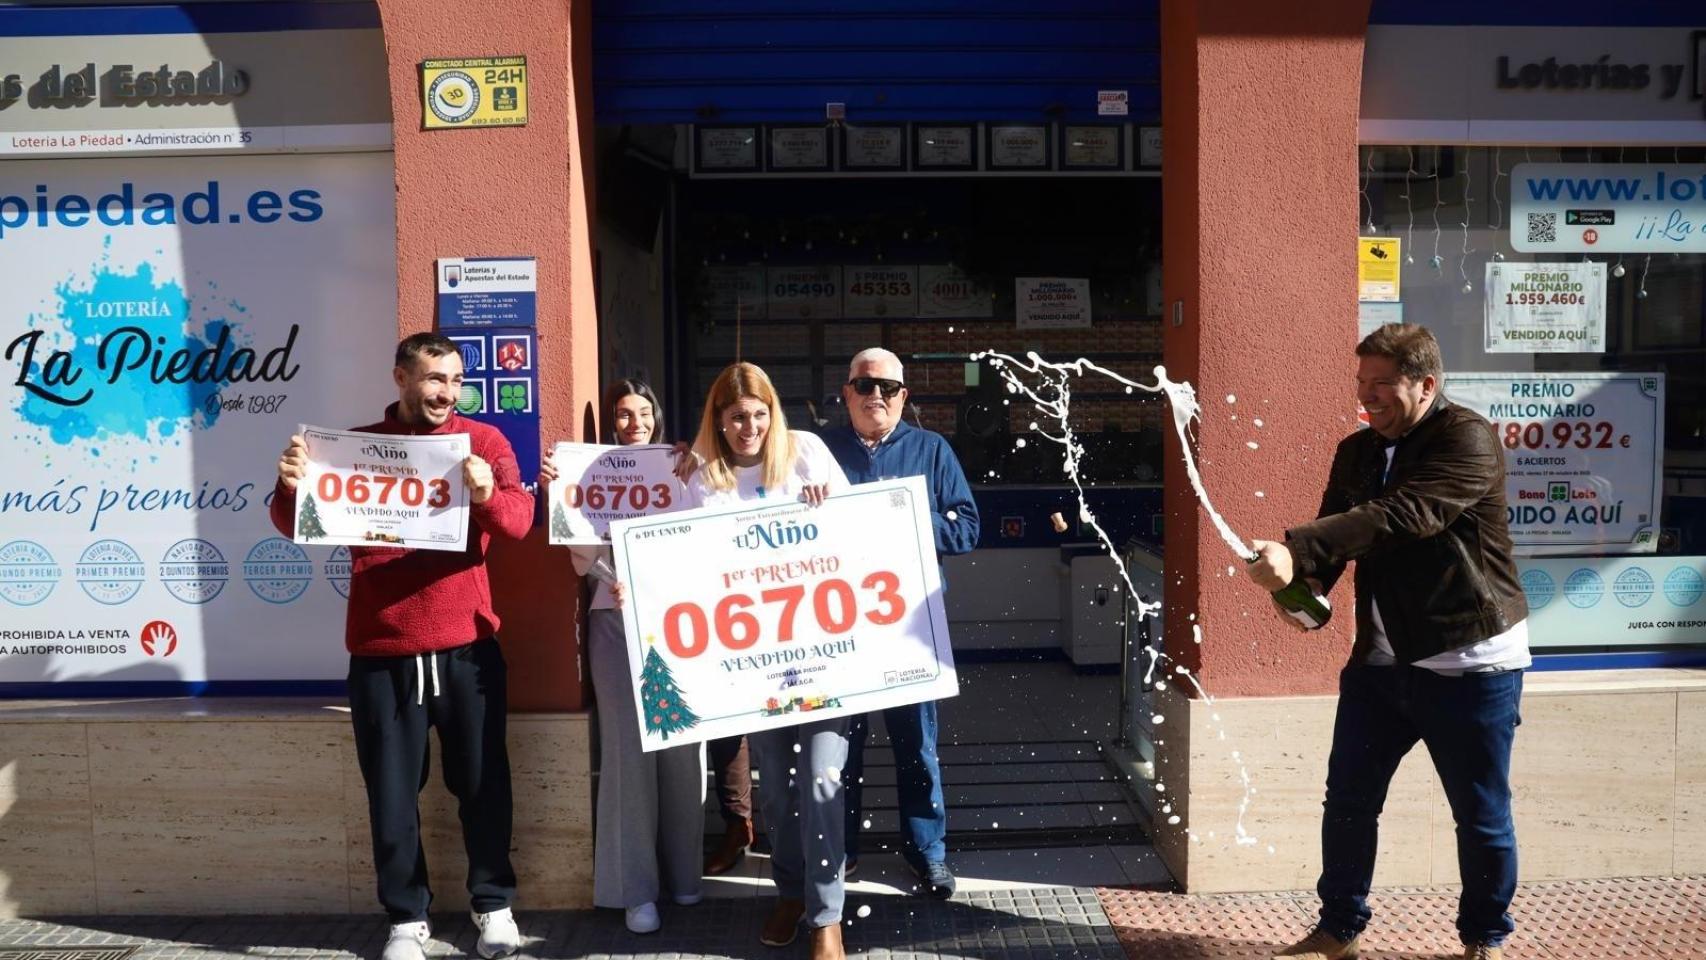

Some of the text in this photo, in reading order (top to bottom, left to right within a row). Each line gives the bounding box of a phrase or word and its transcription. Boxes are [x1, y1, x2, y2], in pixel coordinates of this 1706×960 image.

[425, 56, 525, 69] CONECTADO CENTRAL ALARMAS
[0, 61, 244, 99] s del Estado
[485, 68, 523, 84] 24H
[1496, 54, 1685, 100] Loterías y
[447, 88, 464, 100] 3D
[62, 136, 76, 147] La
[80, 134, 124, 147] Piedad
[134, 131, 220, 145] Administración
[239, 131, 252, 144] 35
[1600, 216, 1612, 224] Play
[464, 275, 494, 283] Apuestas
[508, 273, 530, 281] Estado
[492, 267, 497, 275] y
[864, 272, 907, 281] PREMIO
[1524, 273, 1569, 282] PREMIO
[775, 283, 835, 298] 05490
[850, 282, 912, 297] 45353
[1510, 282, 1583, 292] MILLONARIO
[85, 297, 172, 318] LOTERÍA
[1503, 326, 1587, 341] VENDIDO AQUÍ
[5, 323, 301, 407] La Piedad
[1511, 383, 1574, 398] PREMIO
[205, 393, 288, 416] Desde 1987
[1489, 404, 1595, 418] MILLONARIO
[1619, 434, 1631, 448] €
[369, 444, 408, 460] Niño
[604, 455, 637, 469] Niño
[1517, 457, 1566, 466] 6 ACIERTOS
[368, 464, 418, 476] PREMIO
[603, 474, 644, 484] PREMIO
[317, 472, 452, 509] 06703
[564, 483, 672, 511] 06703
[1519, 490, 1545, 500] Bono
[2, 480, 88, 513] más
[90, 481, 255, 532] premios
[345, 506, 419, 520] VENDIDO AQUÍ
[1564, 500, 1623, 525] AQUÍ
[587, 512, 623, 520] VENDIDO
[658, 525, 691, 537] ENERO
[732, 519, 818, 550] El Niño
[171, 543, 204, 560] NAVIDAD
[0, 567, 62, 577] UNDO PREMIO
[76, 566, 145, 577] PRIMER PREMIO
[160, 565, 229, 577] 2 QUINTOS PREMIOS
[243, 565, 313, 575] TERCER PREMIO
[751, 555, 840, 585] PREMIO
[663, 570, 906, 659] 06703
[1628, 621, 1654, 629] JUEGA
[68, 630, 85, 640] LA
[88, 629, 130, 639] VENTA
[11, 645, 127, 655] AUTOPROHIBIDOS
[720, 635, 856, 673] VENDIDO AQUÍ
[793, 669, 802, 677] LA
[803, 665, 827, 674] PIEDAD
[900, 673, 933, 682] NACIONAL
